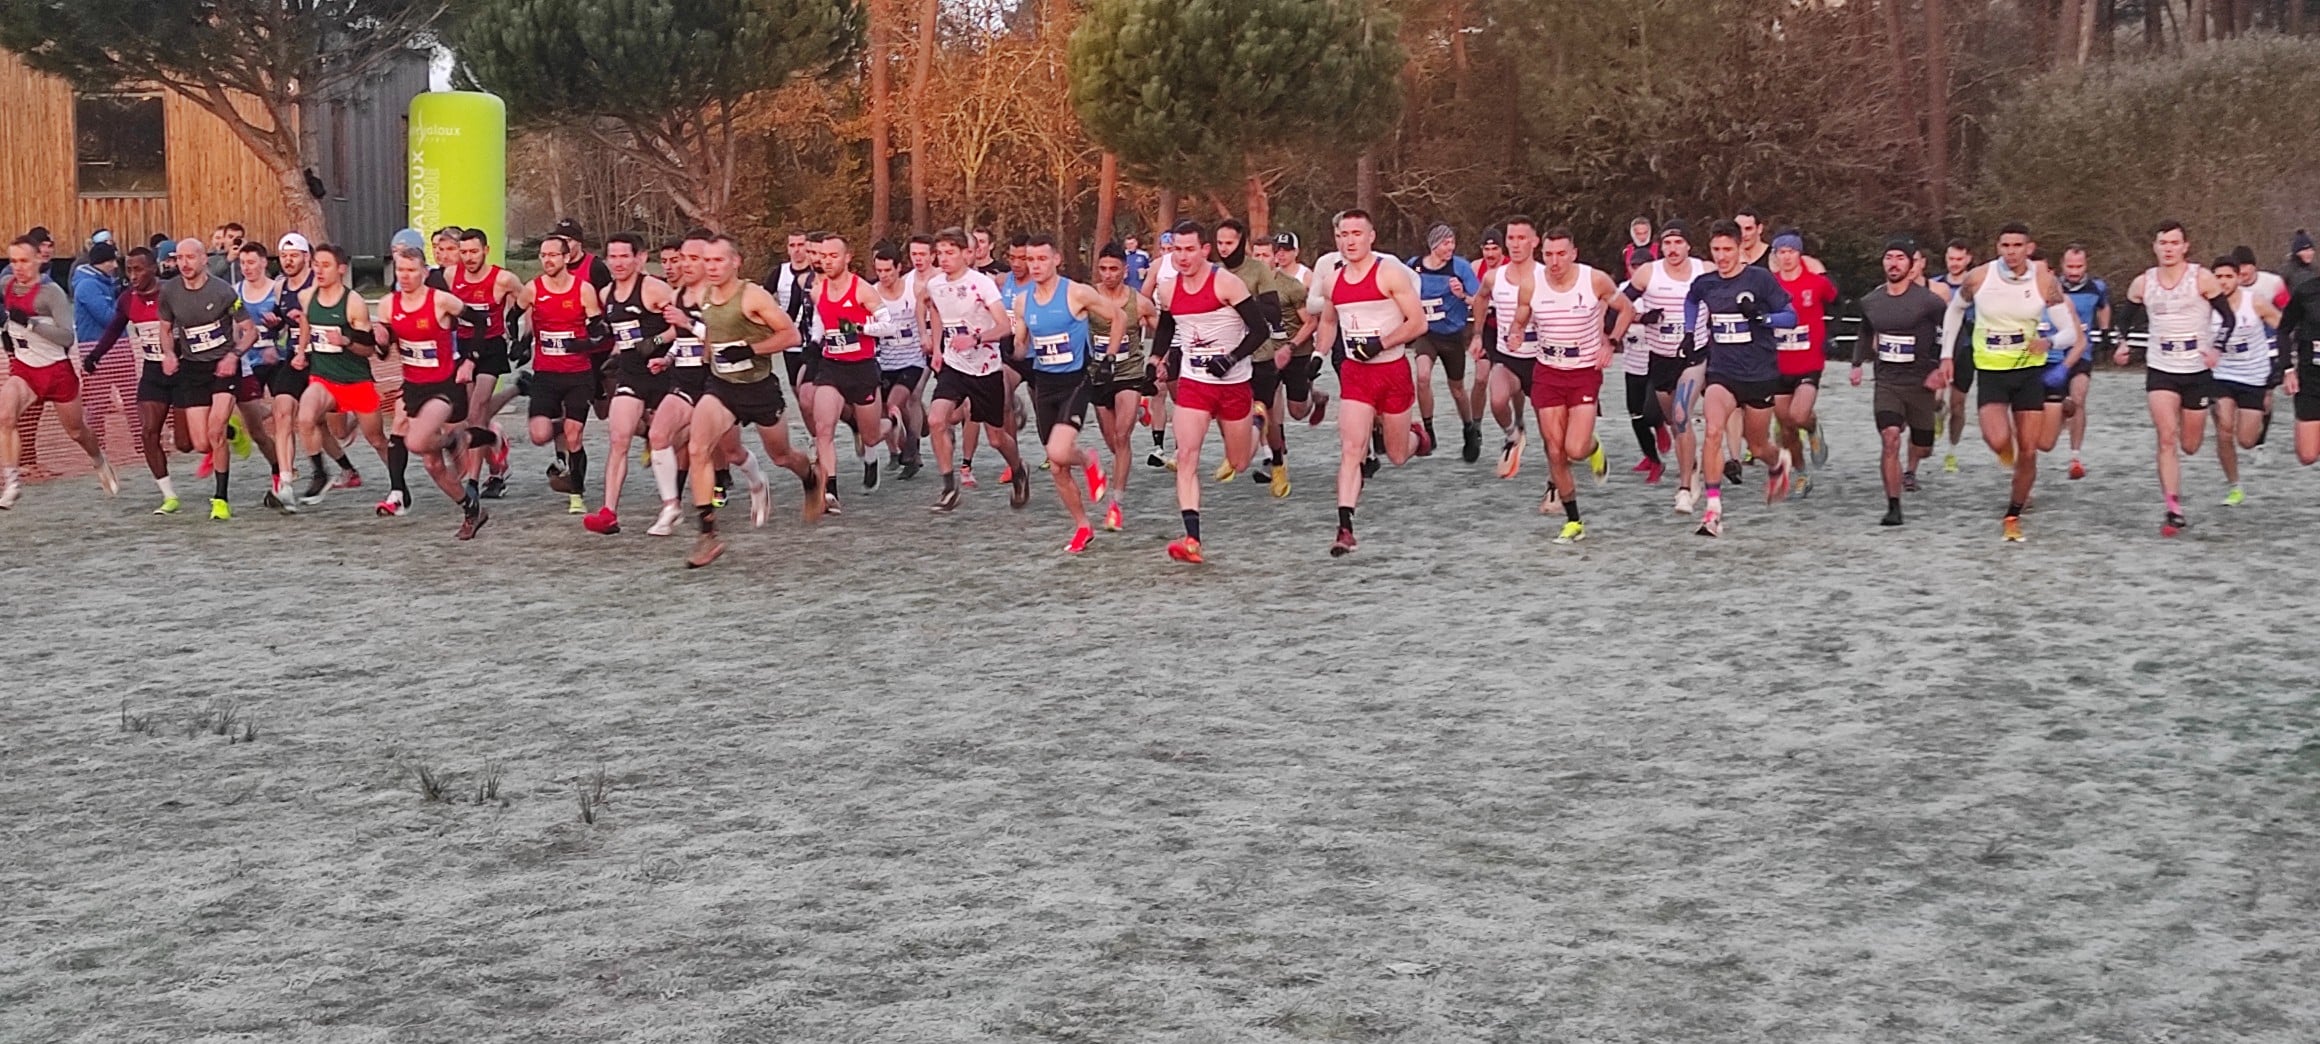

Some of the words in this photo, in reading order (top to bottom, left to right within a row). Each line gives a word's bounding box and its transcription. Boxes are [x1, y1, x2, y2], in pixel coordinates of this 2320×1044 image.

[1723, 322, 1736, 333] 74
[1046, 344, 1058, 355] 44
[1889, 343, 1901, 354] 21
